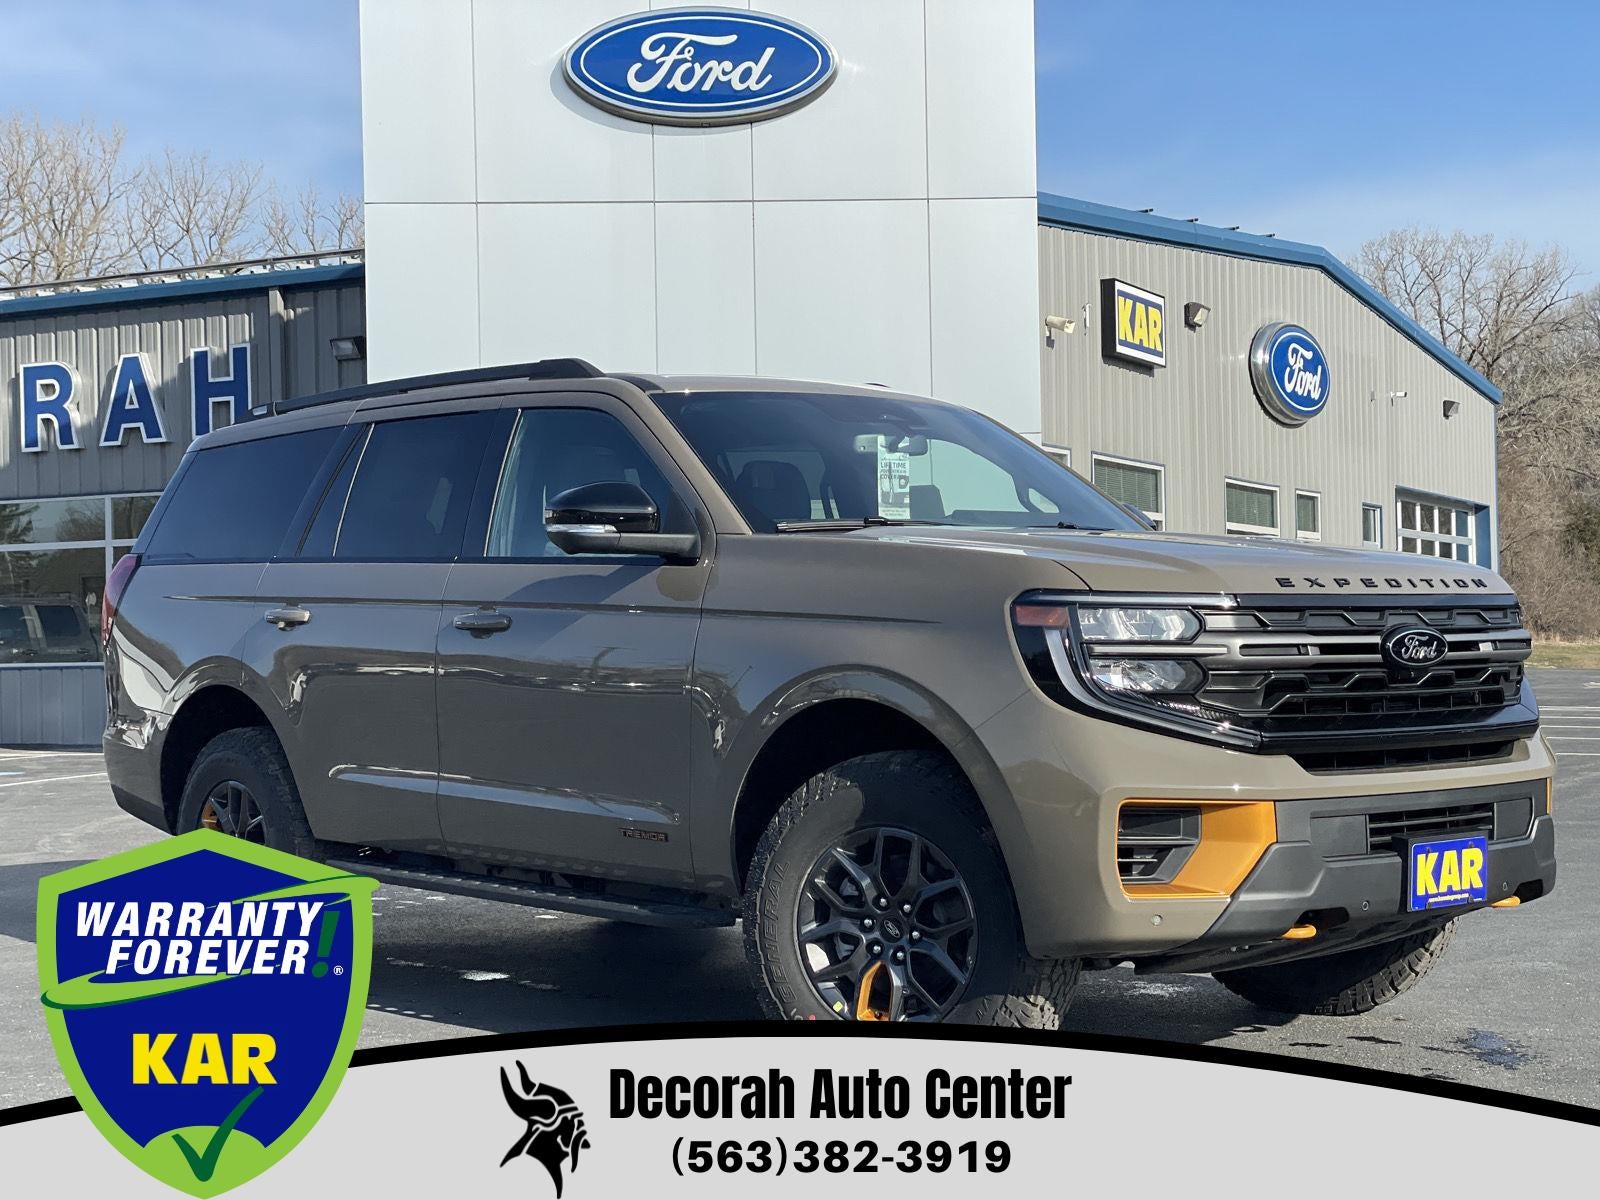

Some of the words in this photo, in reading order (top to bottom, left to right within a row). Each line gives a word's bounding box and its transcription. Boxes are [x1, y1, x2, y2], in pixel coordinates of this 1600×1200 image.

[627, 32, 775, 92] Ford
[1118, 295, 1163, 352] KAR
[20, 343, 252, 452] RAH
[1284, 342, 1322, 401] Ford
[880, 461, 907, 469] LIFTIME
[1275, 577, 1488, 588] EXPEDITION
[1401, 634, 1437, 659] Ford
[617, 827, 669, 842] TREMOR
[1416, 847, 1484, 896] KAR
[763, 862, 798, 1003] GENERAL
